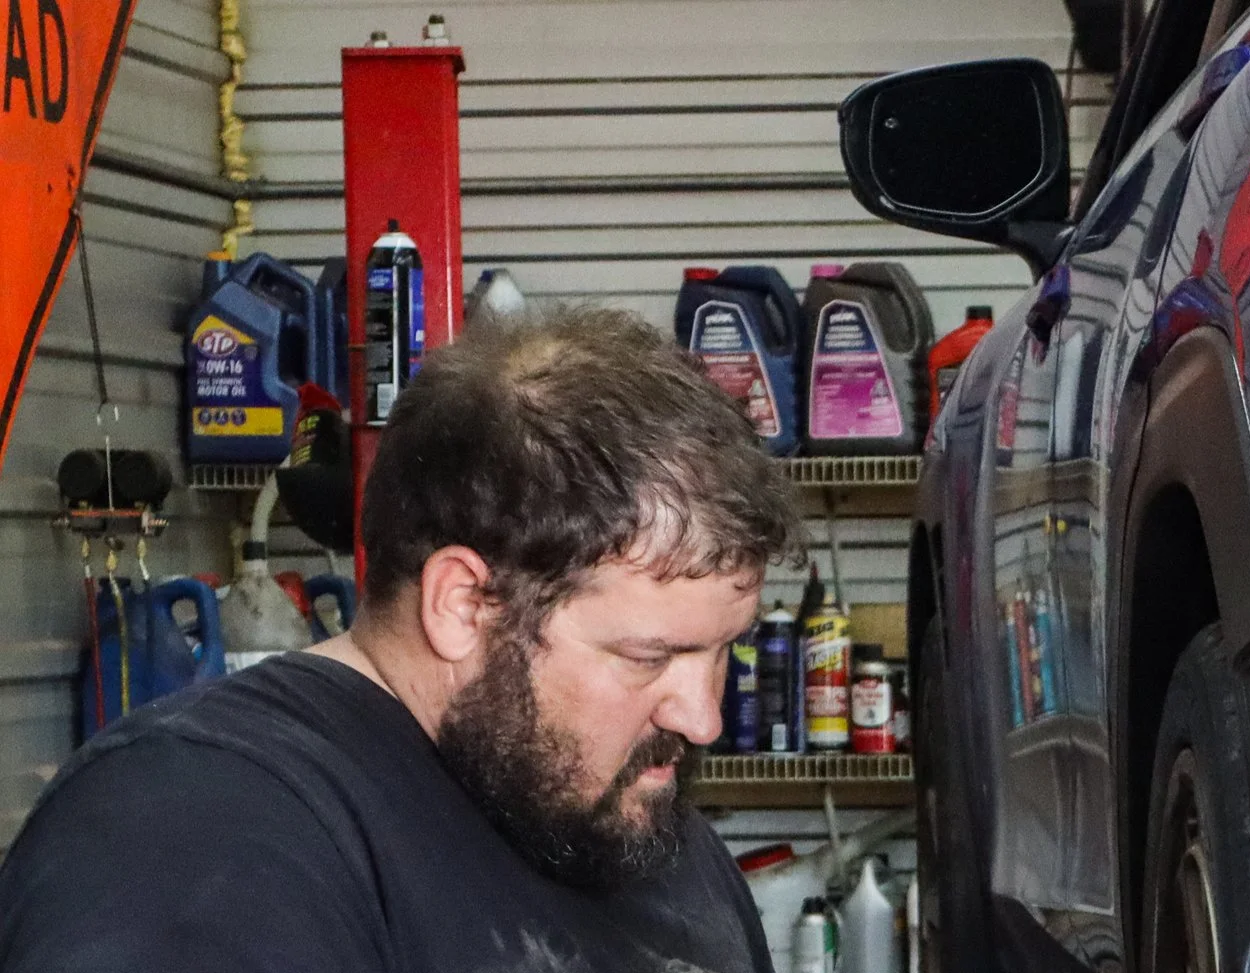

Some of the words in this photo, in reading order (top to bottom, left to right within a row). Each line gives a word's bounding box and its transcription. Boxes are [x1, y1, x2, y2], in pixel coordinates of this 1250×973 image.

[3, 0, 69, 124] AD
[201, 331, 234, 354] STP
[197, 385, 229, 396] MOTOR
[231, 385, 247, 397] OIL
